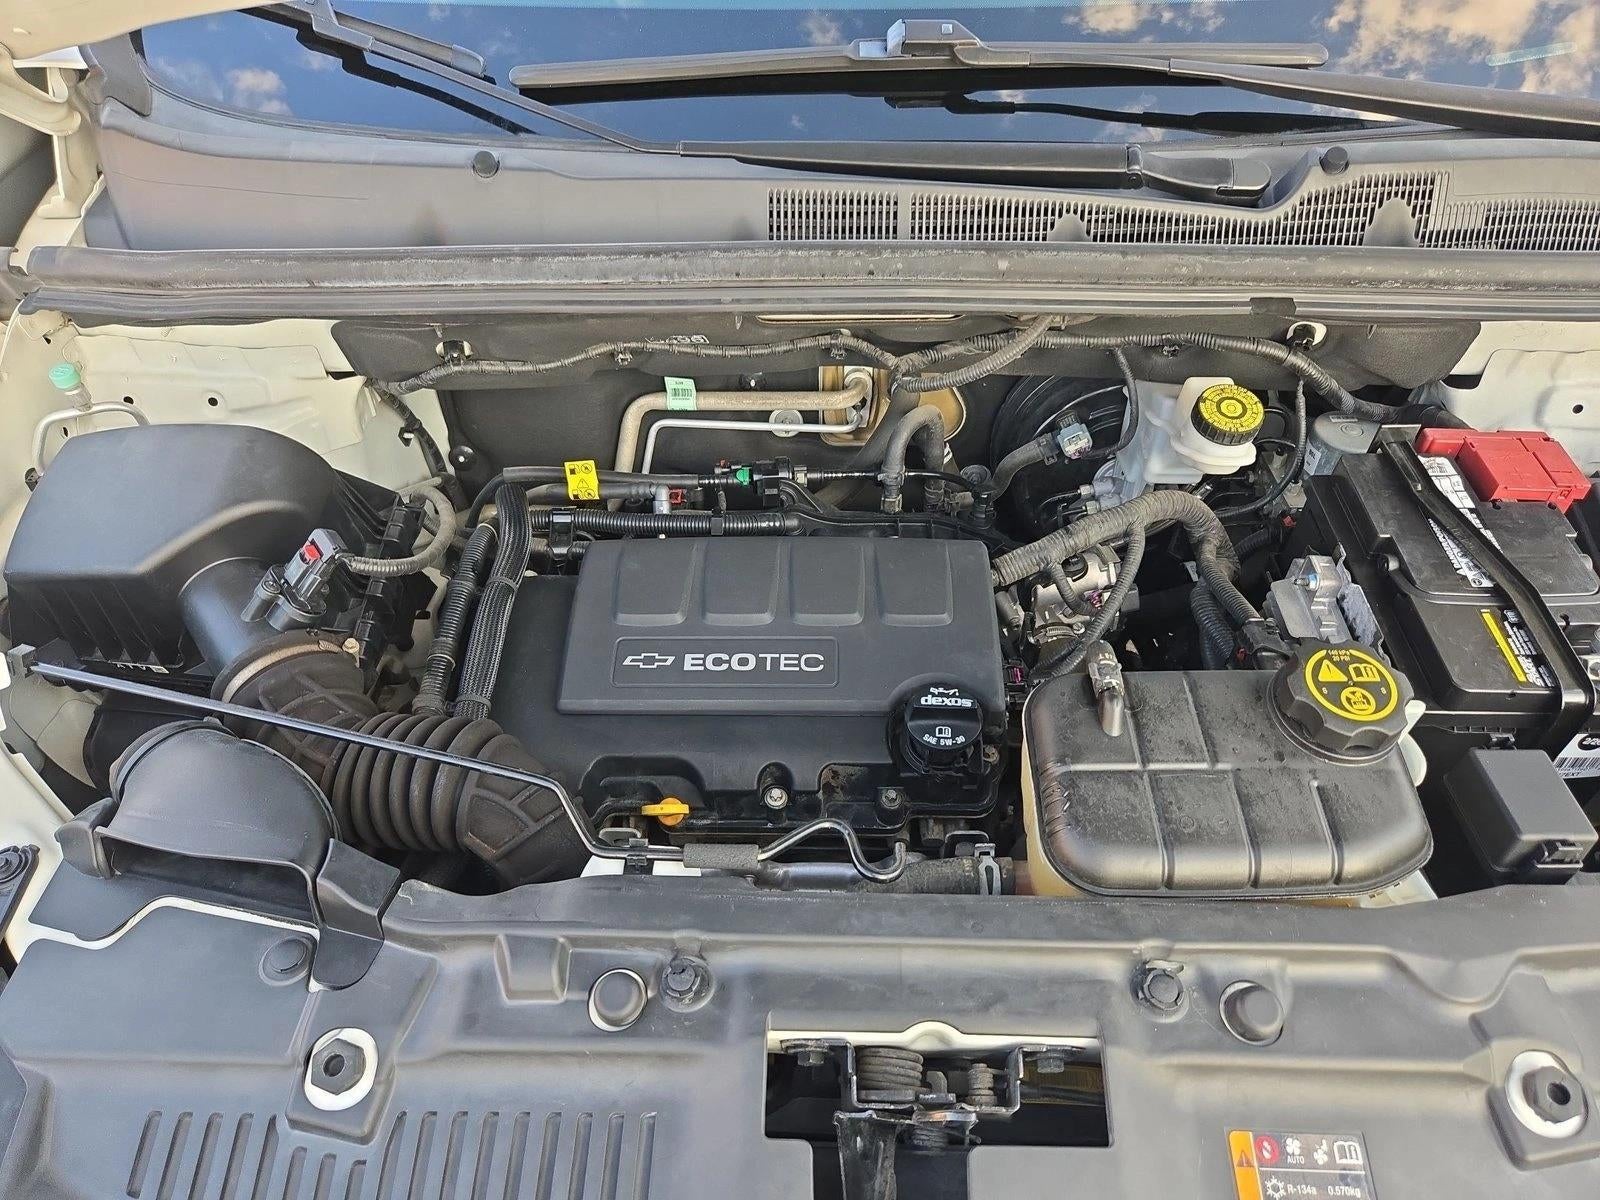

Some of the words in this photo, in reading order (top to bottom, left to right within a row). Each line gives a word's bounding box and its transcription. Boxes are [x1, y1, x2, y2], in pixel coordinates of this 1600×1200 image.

[683, 652, 825, 672] ECOTEC
[920, 694, 974, 708] dexos
[922, 733, 938, 745] SAE
[939, 735, 966, 746] 5W-30
[1287, 1155, 1305, 1164] AUTO
[1287, 1184, 1317, 1195] R-134a
[1327, 1185, 1361, 1198] 0.570kg
